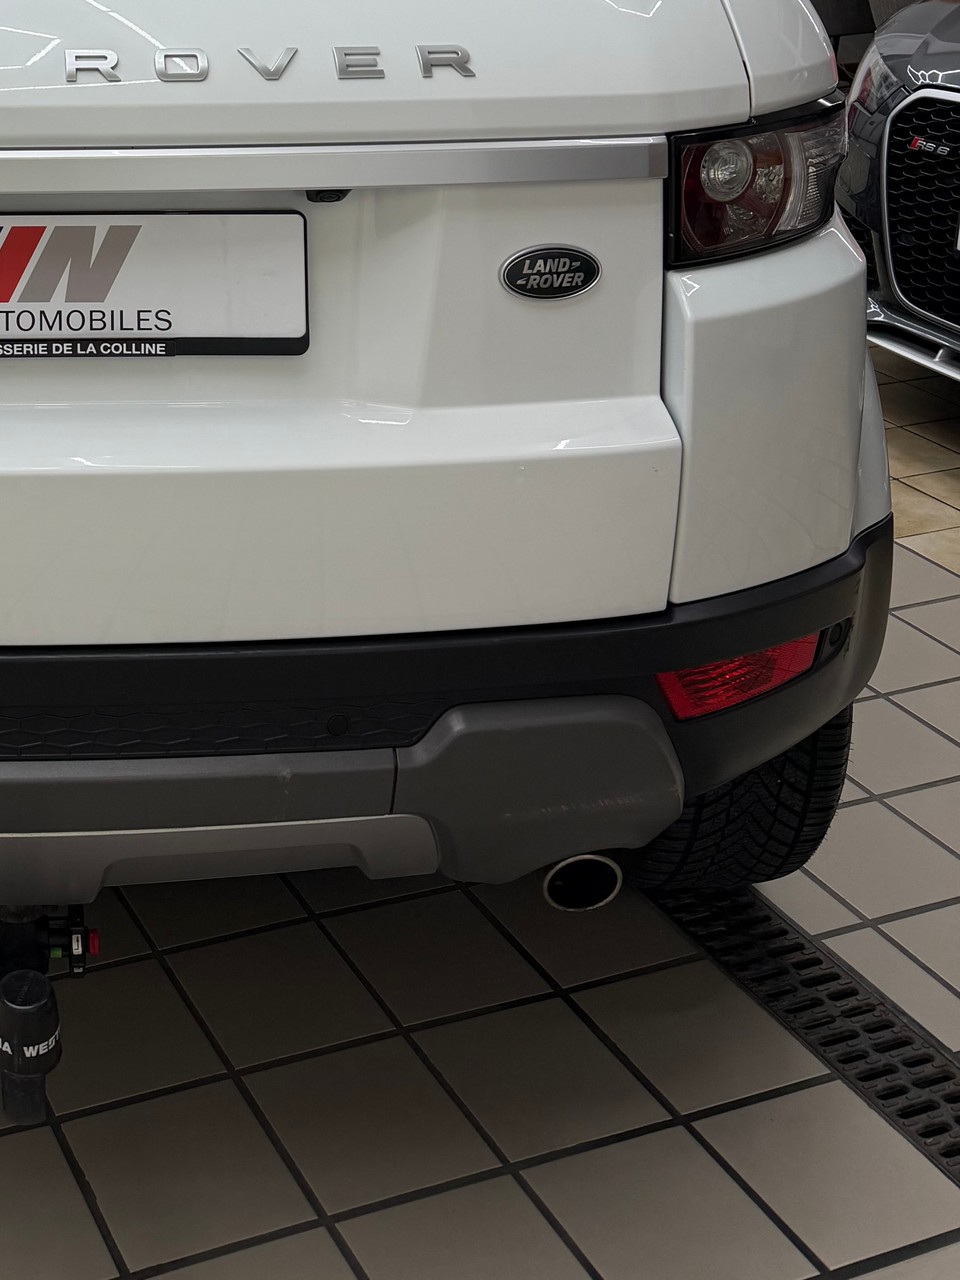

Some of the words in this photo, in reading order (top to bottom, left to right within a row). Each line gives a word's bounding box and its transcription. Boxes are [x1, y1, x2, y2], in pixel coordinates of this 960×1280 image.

[64, 44, 477, 83] ROVER
[522, 258, 571, 274] LAND
[526, 272, 585, 289] ROVER
[52, 343, 73, 355] DE
[76, 343, 97, 355] LA
[100, 342, 166, 356] COLLINE
